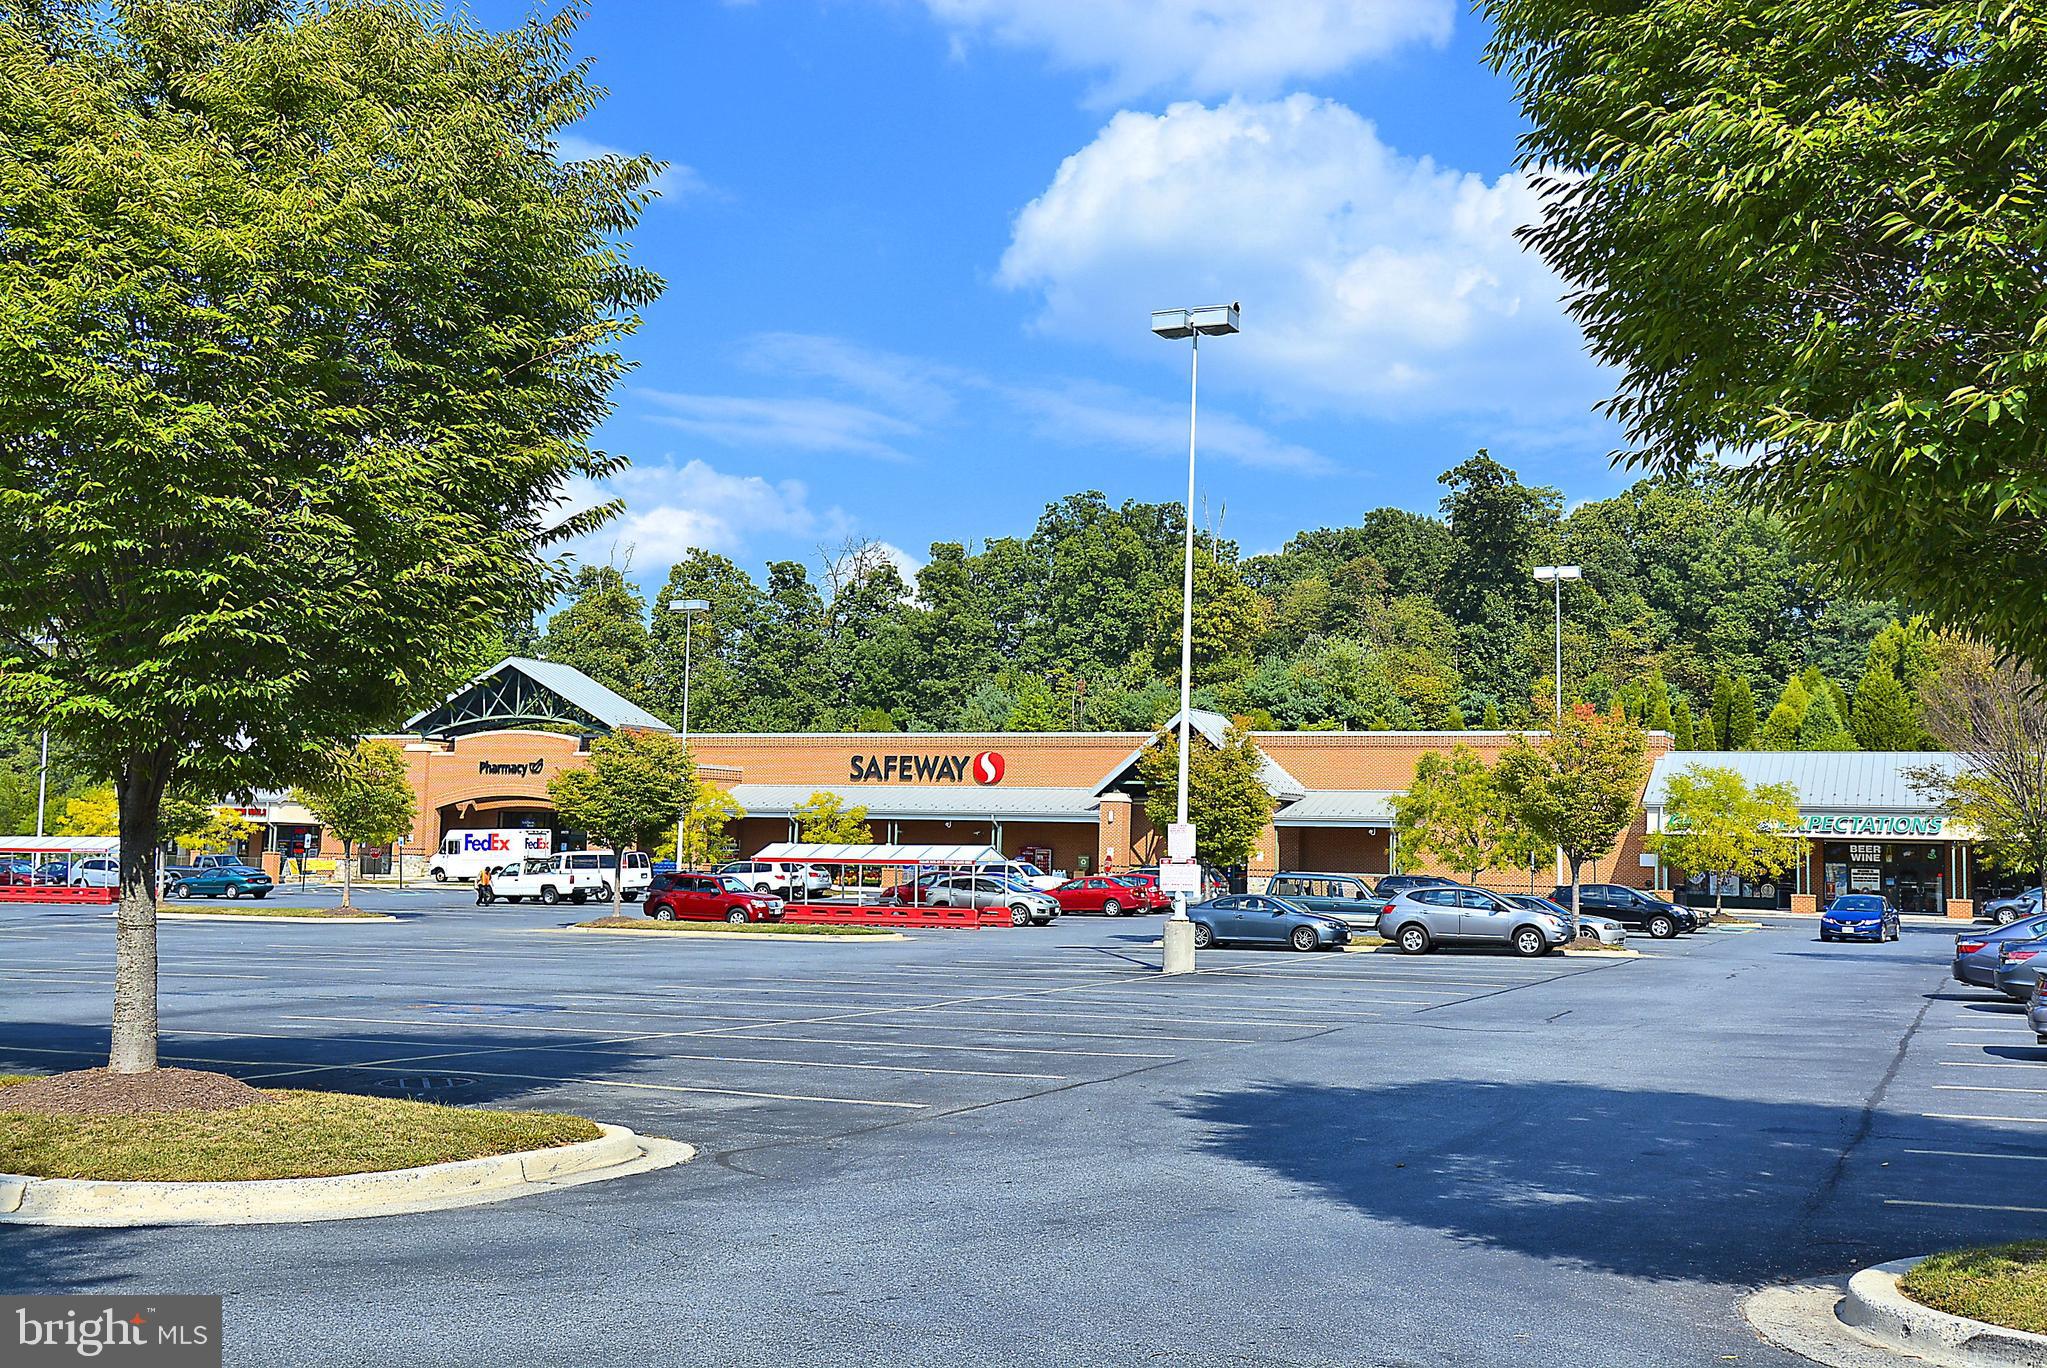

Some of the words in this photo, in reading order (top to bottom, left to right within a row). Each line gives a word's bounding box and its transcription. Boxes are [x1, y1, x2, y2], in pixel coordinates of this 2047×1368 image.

[479, 761, 528, 777] Pharmacy
[850, 755, 970, 782] SAFEWAY
[465, 833, 510, 851] FedEx
[525, 838, 549, 850] FedEx
[1850, 845, 1881, 853] BEER
[1851, 854, 1881, 862] WINE
